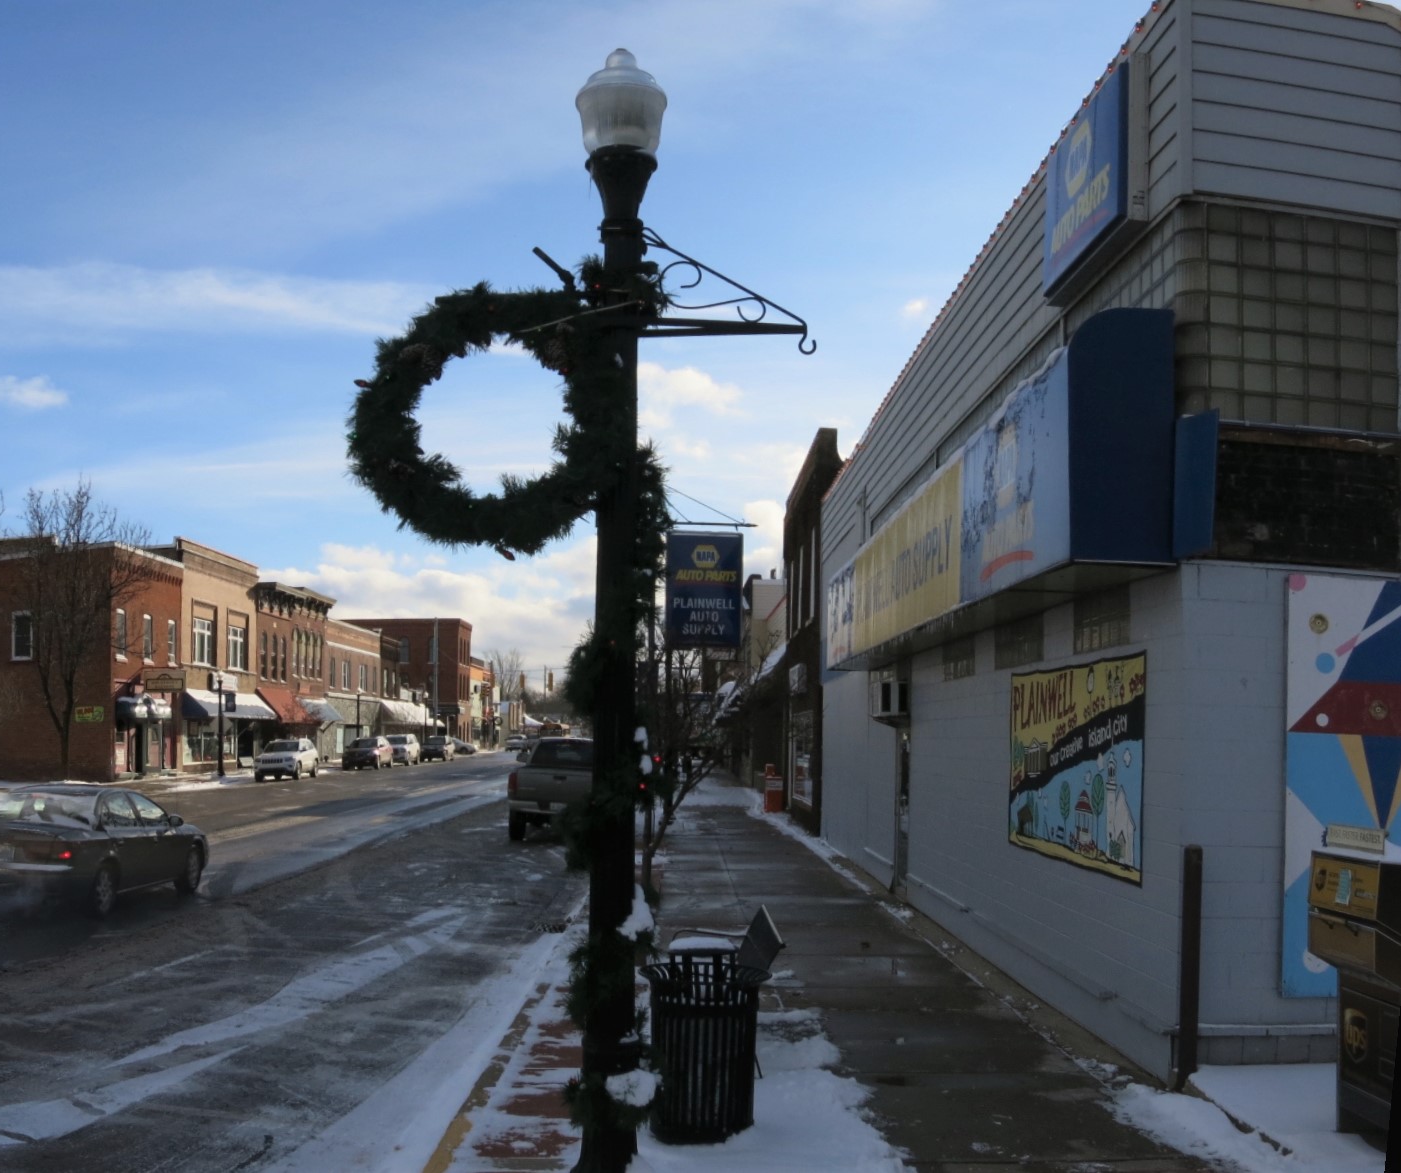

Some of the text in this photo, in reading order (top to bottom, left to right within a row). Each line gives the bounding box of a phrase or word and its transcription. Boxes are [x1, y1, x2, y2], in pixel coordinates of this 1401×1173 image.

[1051, 163, 1111, 255] AUTO PARTS
[696, 551, 716, 562] NAPA
[913, 514, 952, 591] SUPPLY
[676, 569, 737, 582] AUTO PARTS
[673, 598, 735, 609] PLAINWELL
[690, 611, 719, 622] AUTO
[682, 624, 725, 635] SUPPLY
[1013, 670, 1076, 732] PLAINWELL
[1050, 714, 1128, 767] our creative island city
[1344, 1024, 1368, 1054] ups
